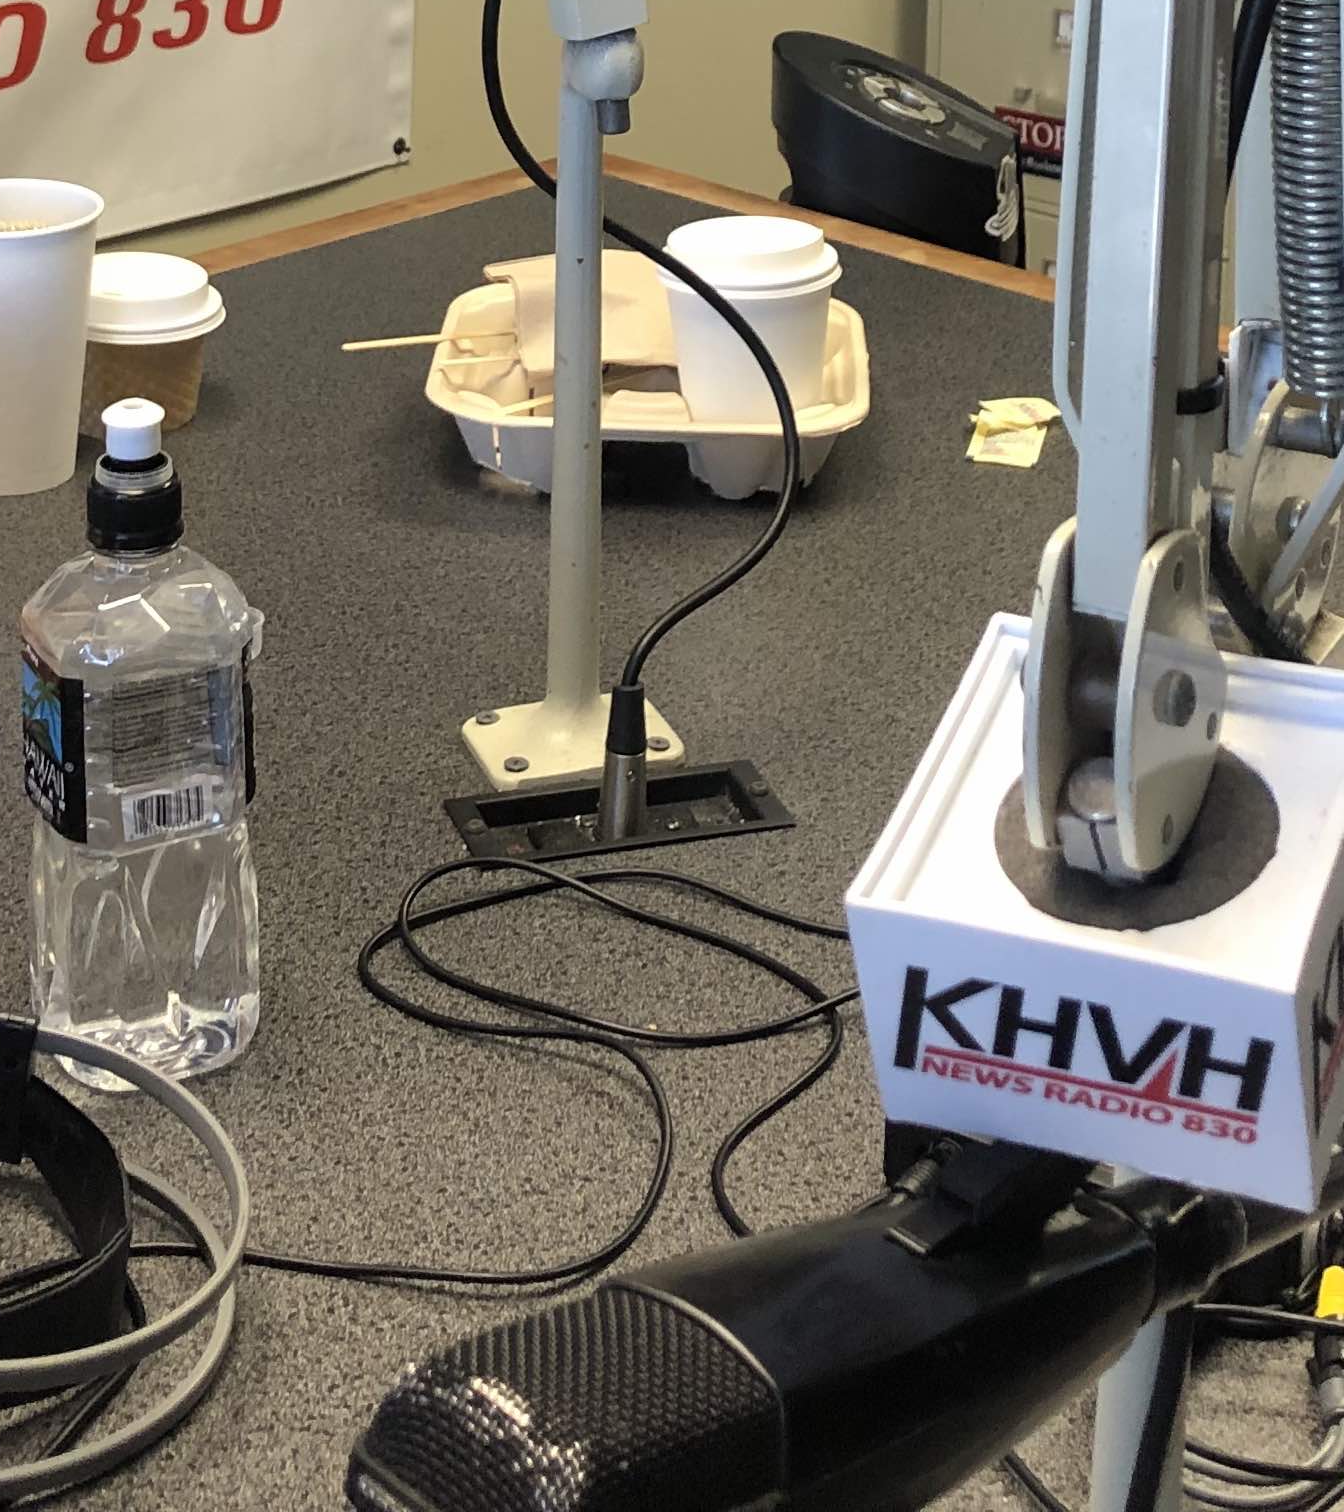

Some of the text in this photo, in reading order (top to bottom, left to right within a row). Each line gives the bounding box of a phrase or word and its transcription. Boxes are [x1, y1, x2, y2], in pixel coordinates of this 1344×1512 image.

[894, 964, 1276, 1112] KHVH
[921, 1055, 1259, 1145] NEWS RADIO 830
